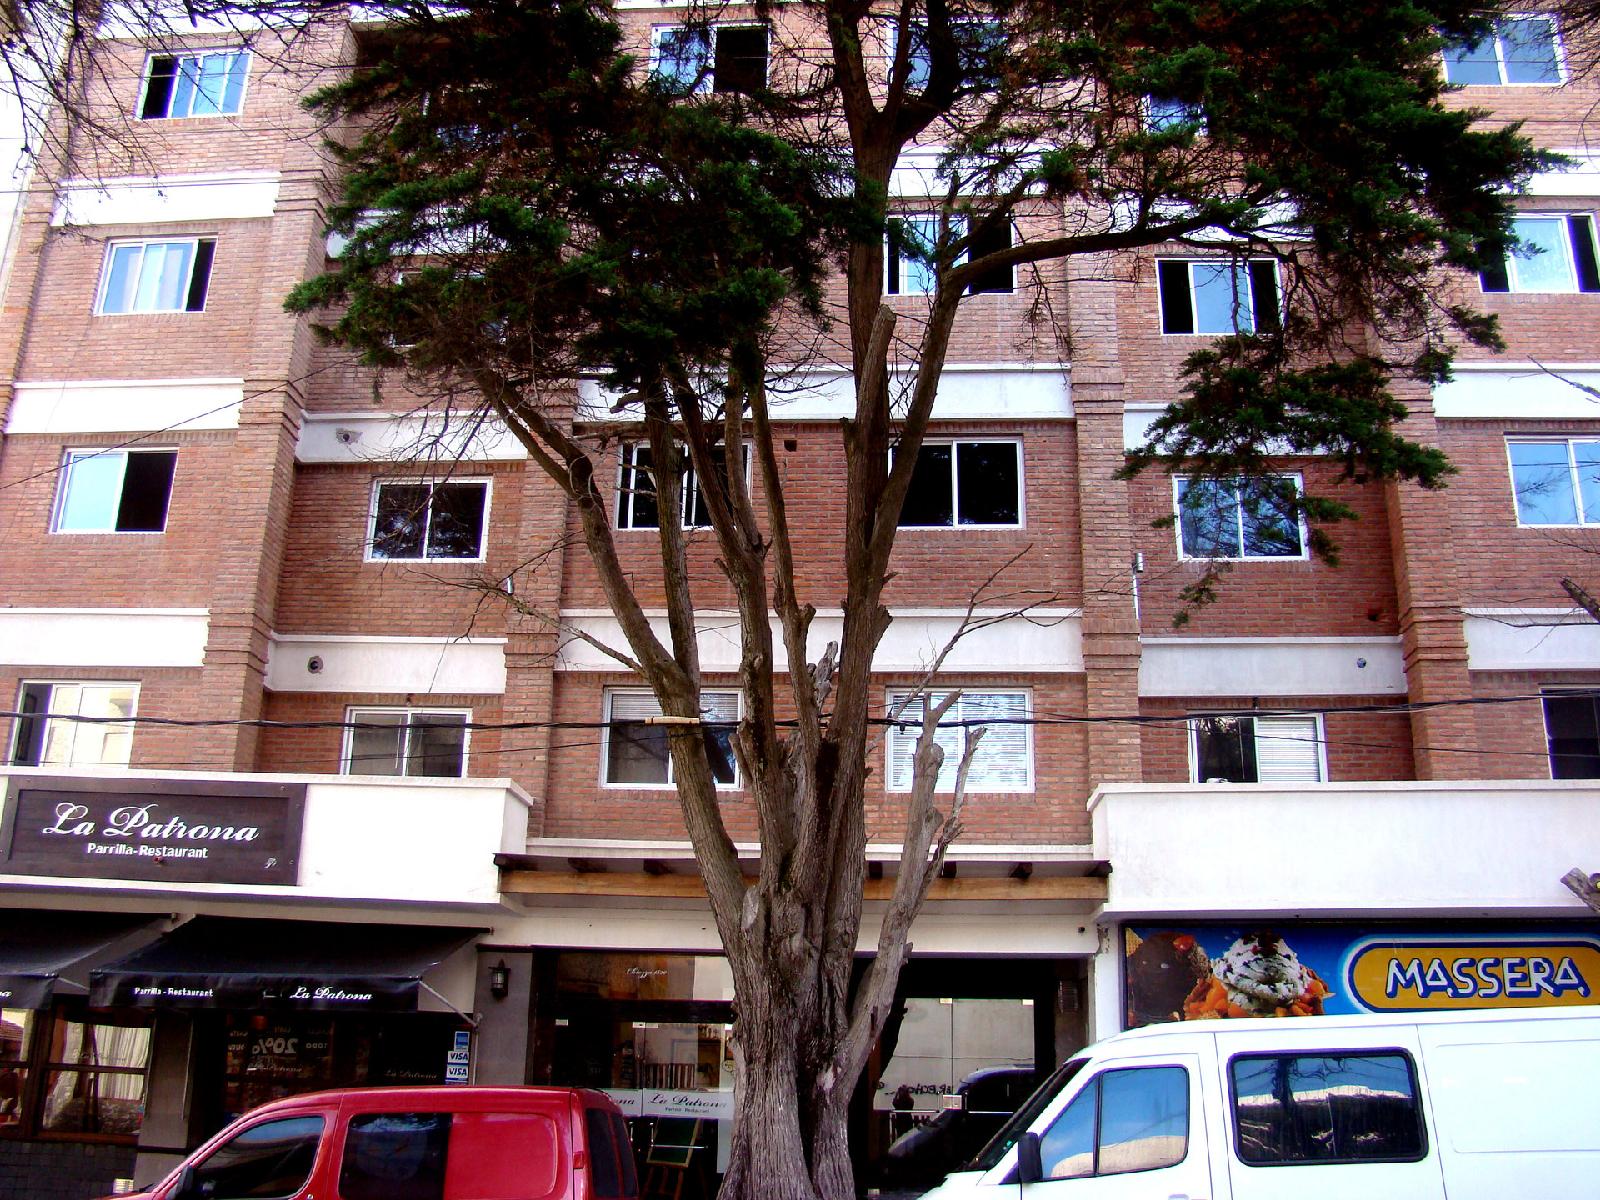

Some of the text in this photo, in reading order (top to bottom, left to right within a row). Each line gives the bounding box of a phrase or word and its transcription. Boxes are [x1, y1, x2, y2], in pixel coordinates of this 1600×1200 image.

[43, 803, 259, 842] La Patrona
[87, 842, 208, 859] Parrilla-Restaurant
[1386, 957, 1591, 999] MASSERA
[134, 987, 162, 995] Parrilla
[168, 987, 214, 998] Restaurant
[289, 985, 373, 1000] La Patrona
[451, 1052, 468, 1060] VISA
[449, 1067, 467, 1076] VISA
[648, 1093, 667, 1104] La
[672, 1095, 727, 1108] Patrona
